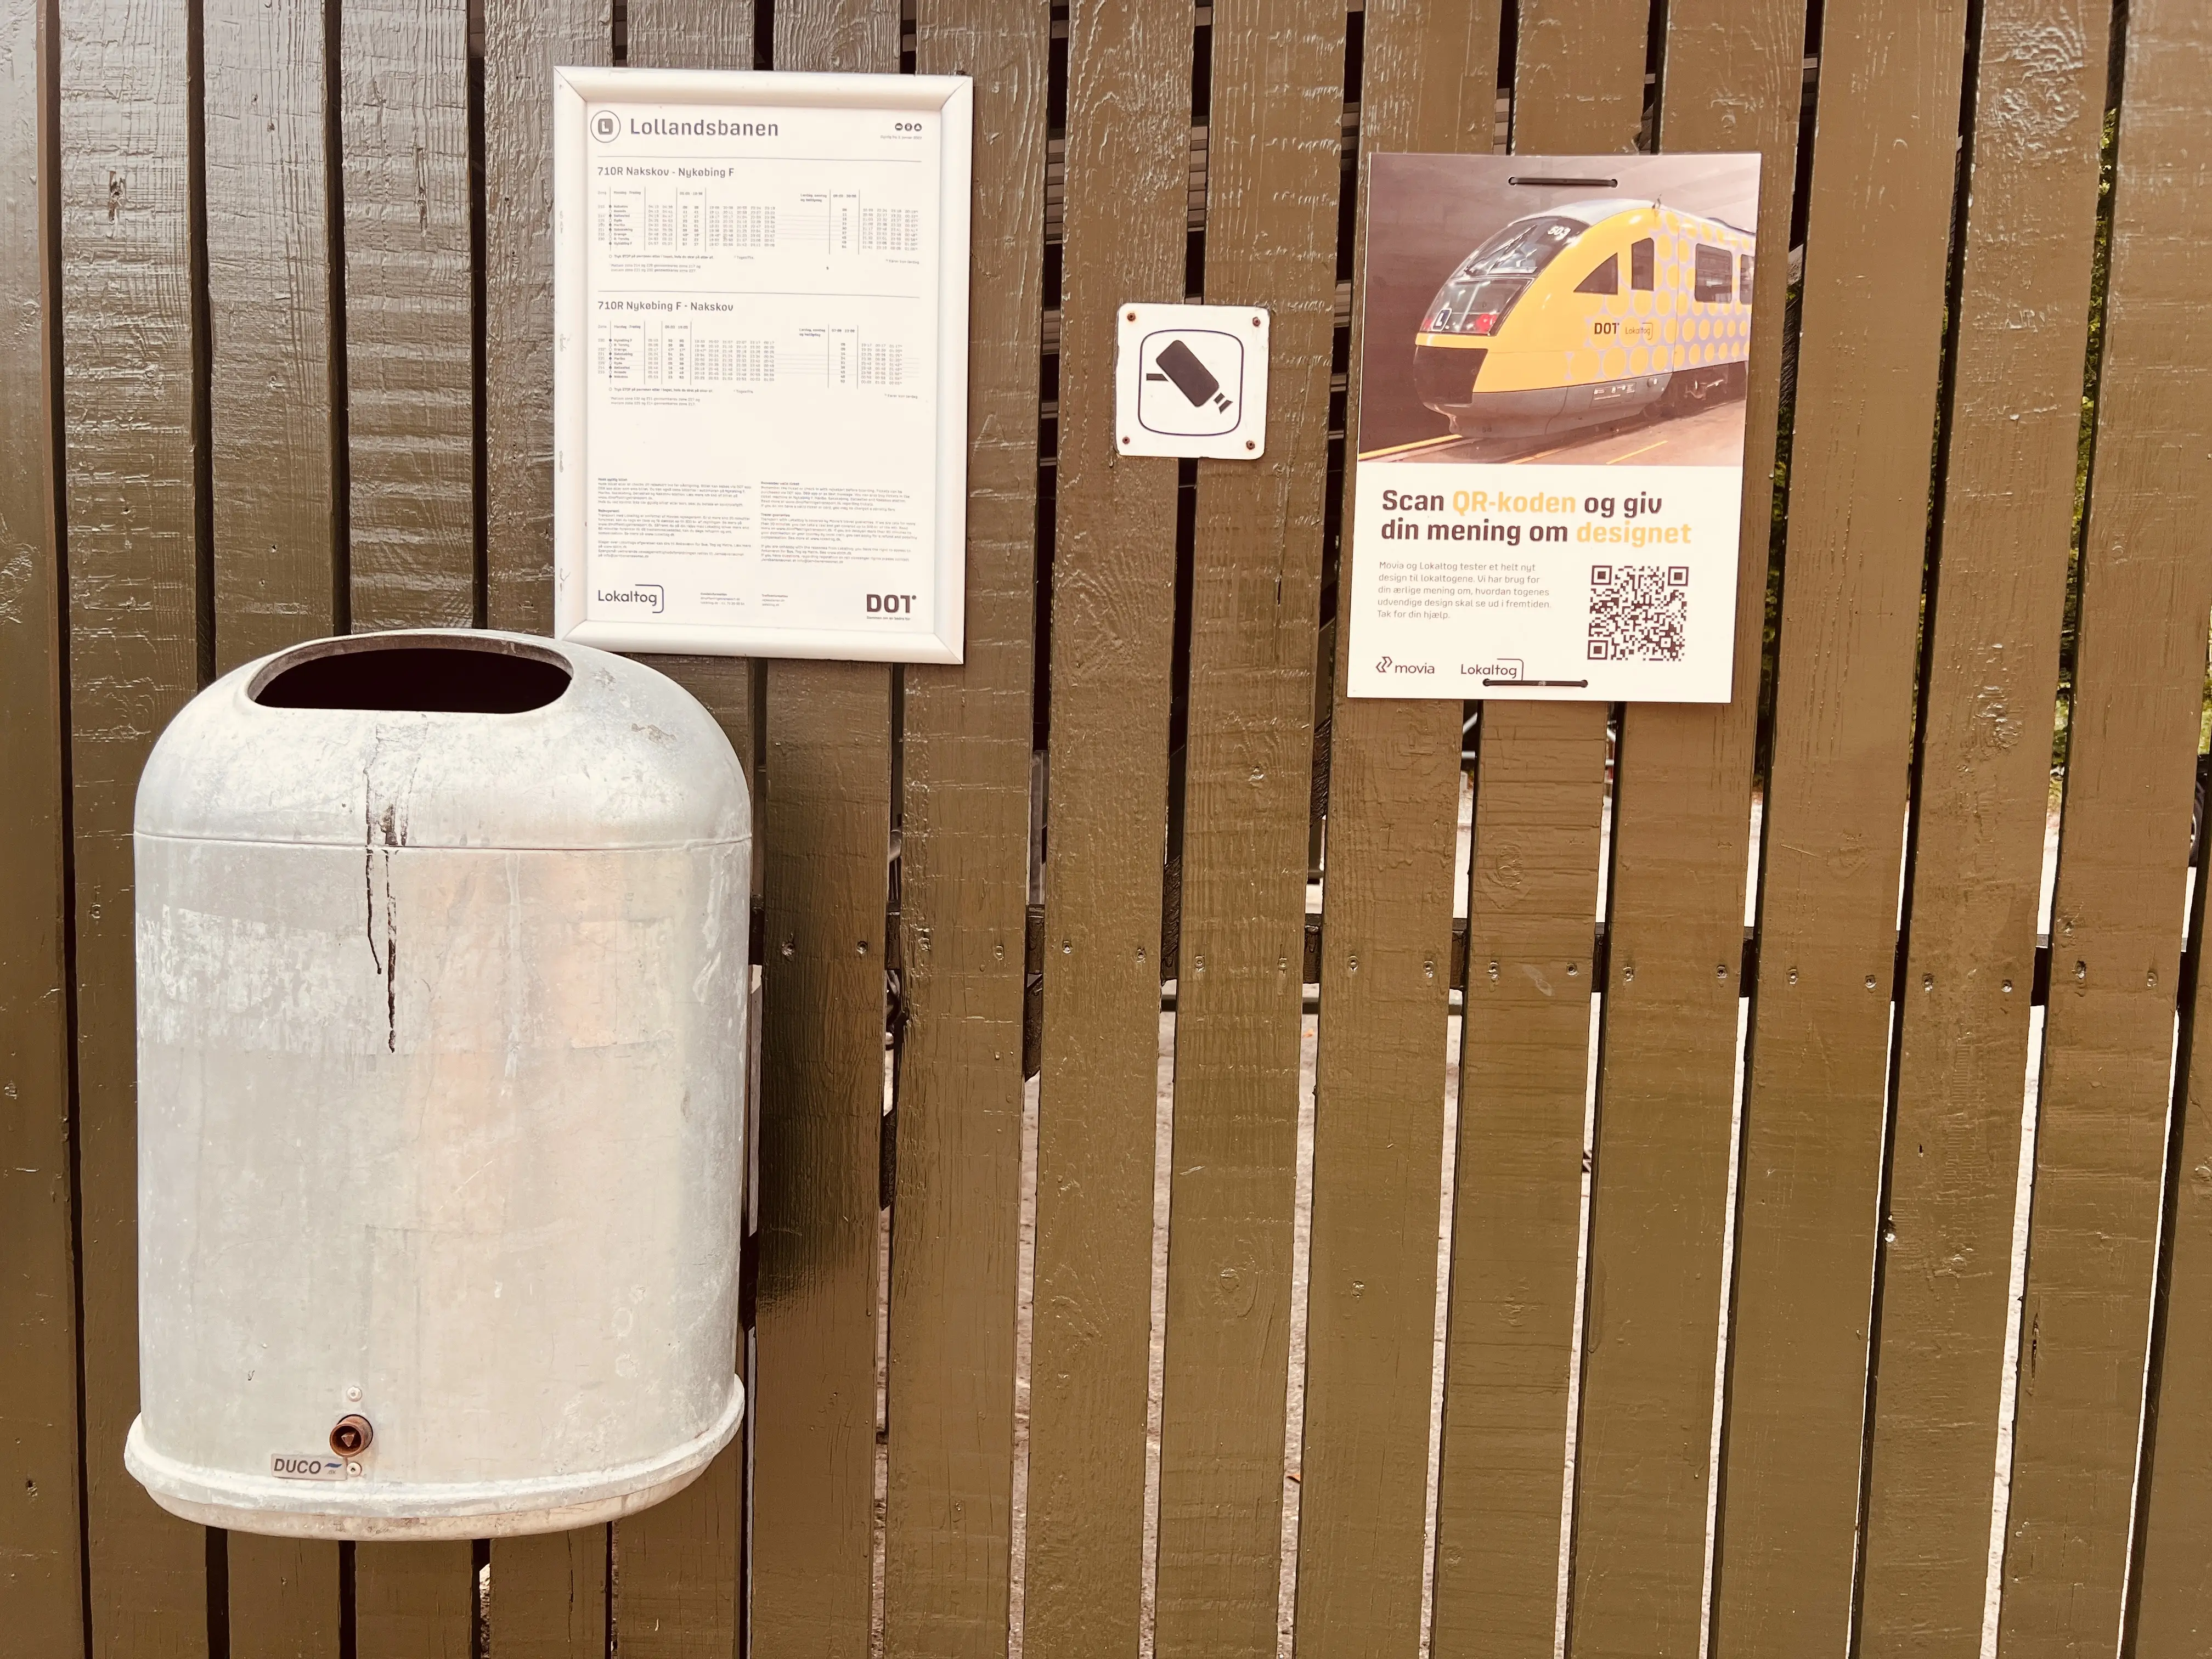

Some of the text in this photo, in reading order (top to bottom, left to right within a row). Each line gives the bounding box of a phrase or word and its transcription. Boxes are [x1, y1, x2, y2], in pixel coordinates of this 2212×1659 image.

[631, 119, 778, 136] Lollandsbanen
[598, 167, 623, 175] 710R
[627, 167, 669, 176] Nakskov
[679, 168, 725, 178] Nykøbing
[1548, 225, 1571, 240] 503
[598, 301, 623, 309] 710R
[627, 301, 672, 312] Nykøbing
[676, 302, 681, 310] F
[691, 302, 733, 311] Nakskov
[1595, 323, 1616, 334] DOT
[1626, 326, 1650, 336] Lokaltog
[1383, 490, 1662, 518] Scan QR-koden og giv
[1382, 517, 1691, 548] din mening om designet
[1420, 562, 1457, 571] Lokaltog
[1521, 564, 1535, 572] nyt
[1379, 574, 1407, 583] design
[1421, 575, 1475, 584] lokaltogene.
[1505, 576, 1524, 584] brug
[1393, 586, 1420, 595] ærlige
[1424, 586, 1454, 596] mening
[1457, 589, 1474, 597] om,
[1514, 589, 1549, 597] togenes
[599, 590, 657, 606] Lokaltog
[867, 594, 910, 613] DOT
[1378, 599, 1421, 607] udvendige
[1425, 599, 1452, 608] design
[1424, 611, 1450, 620] hjælp.
[1395, 663, 1434, 674] movia
[1461, 664, 1516, 679] Lokaltog
[274, 1459, 321, 1474] DUCO
